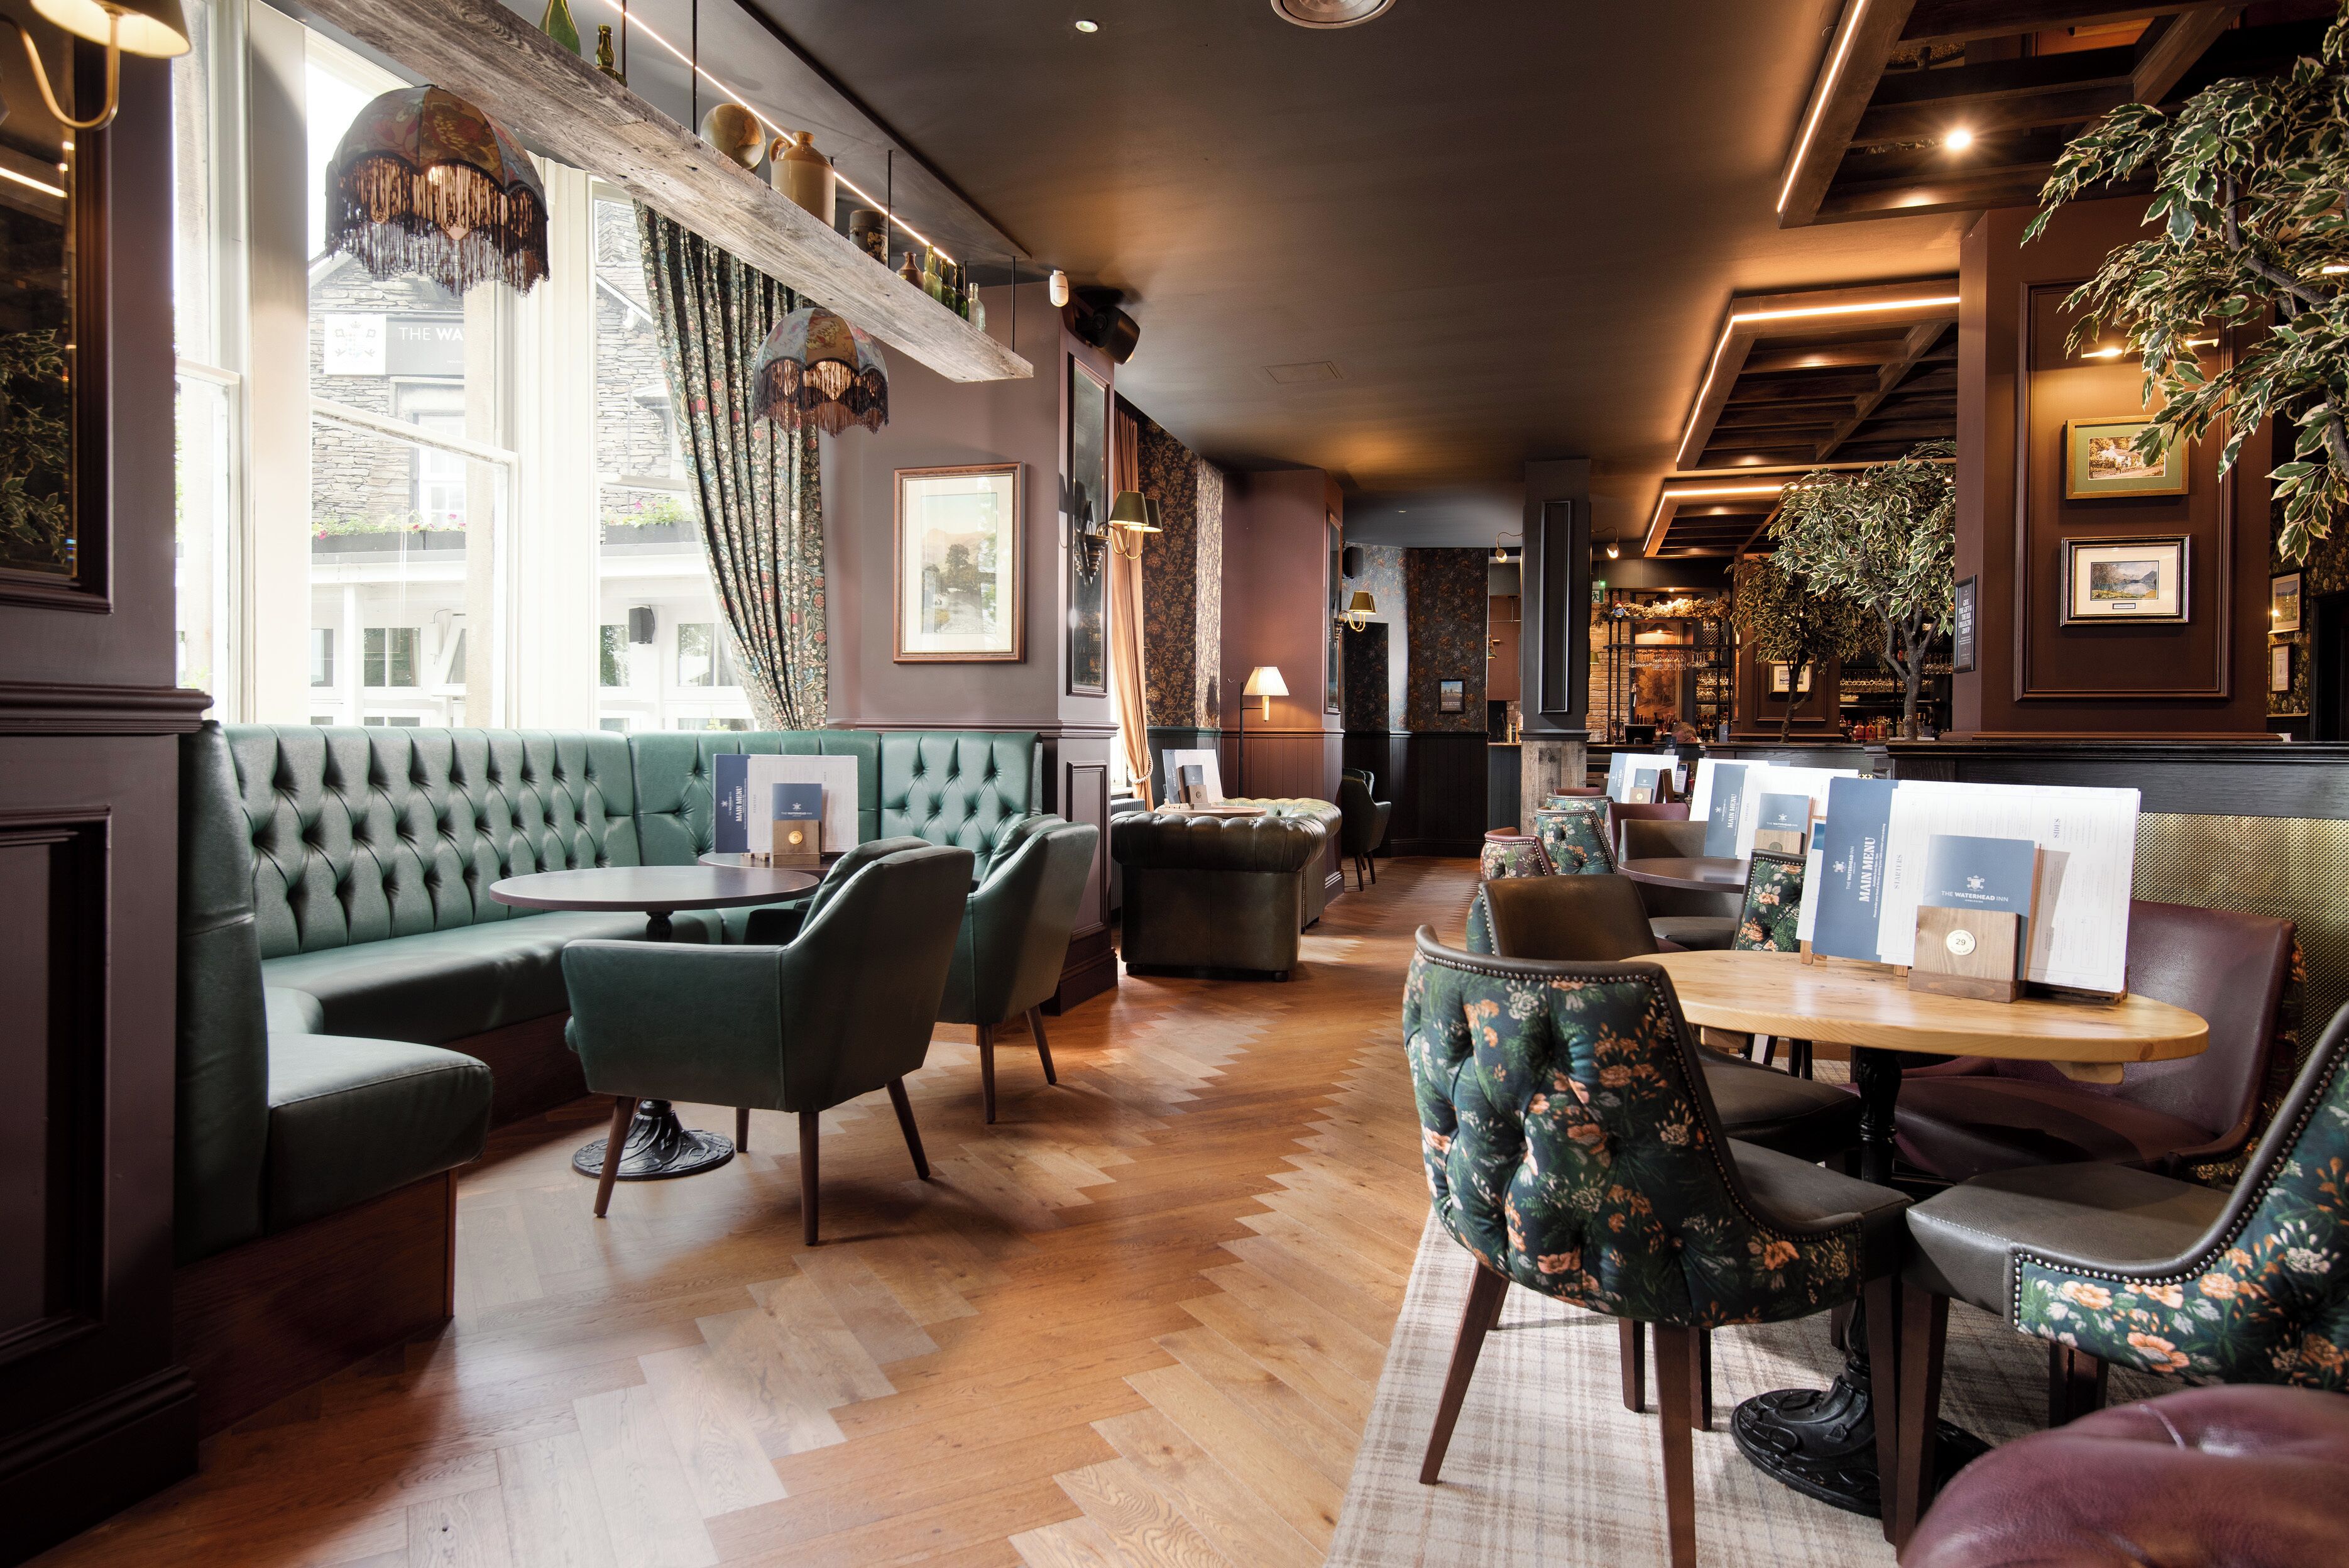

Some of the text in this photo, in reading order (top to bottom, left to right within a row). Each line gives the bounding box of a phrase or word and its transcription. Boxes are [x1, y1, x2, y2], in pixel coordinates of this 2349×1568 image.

[398, 327, 431, 340] THE
[1859, 837, 1876, 902] MAIN MENU
[1894, 855, 1903, 890] STARTERS
[1955, 892, 1995, 901] WATERHEAD
